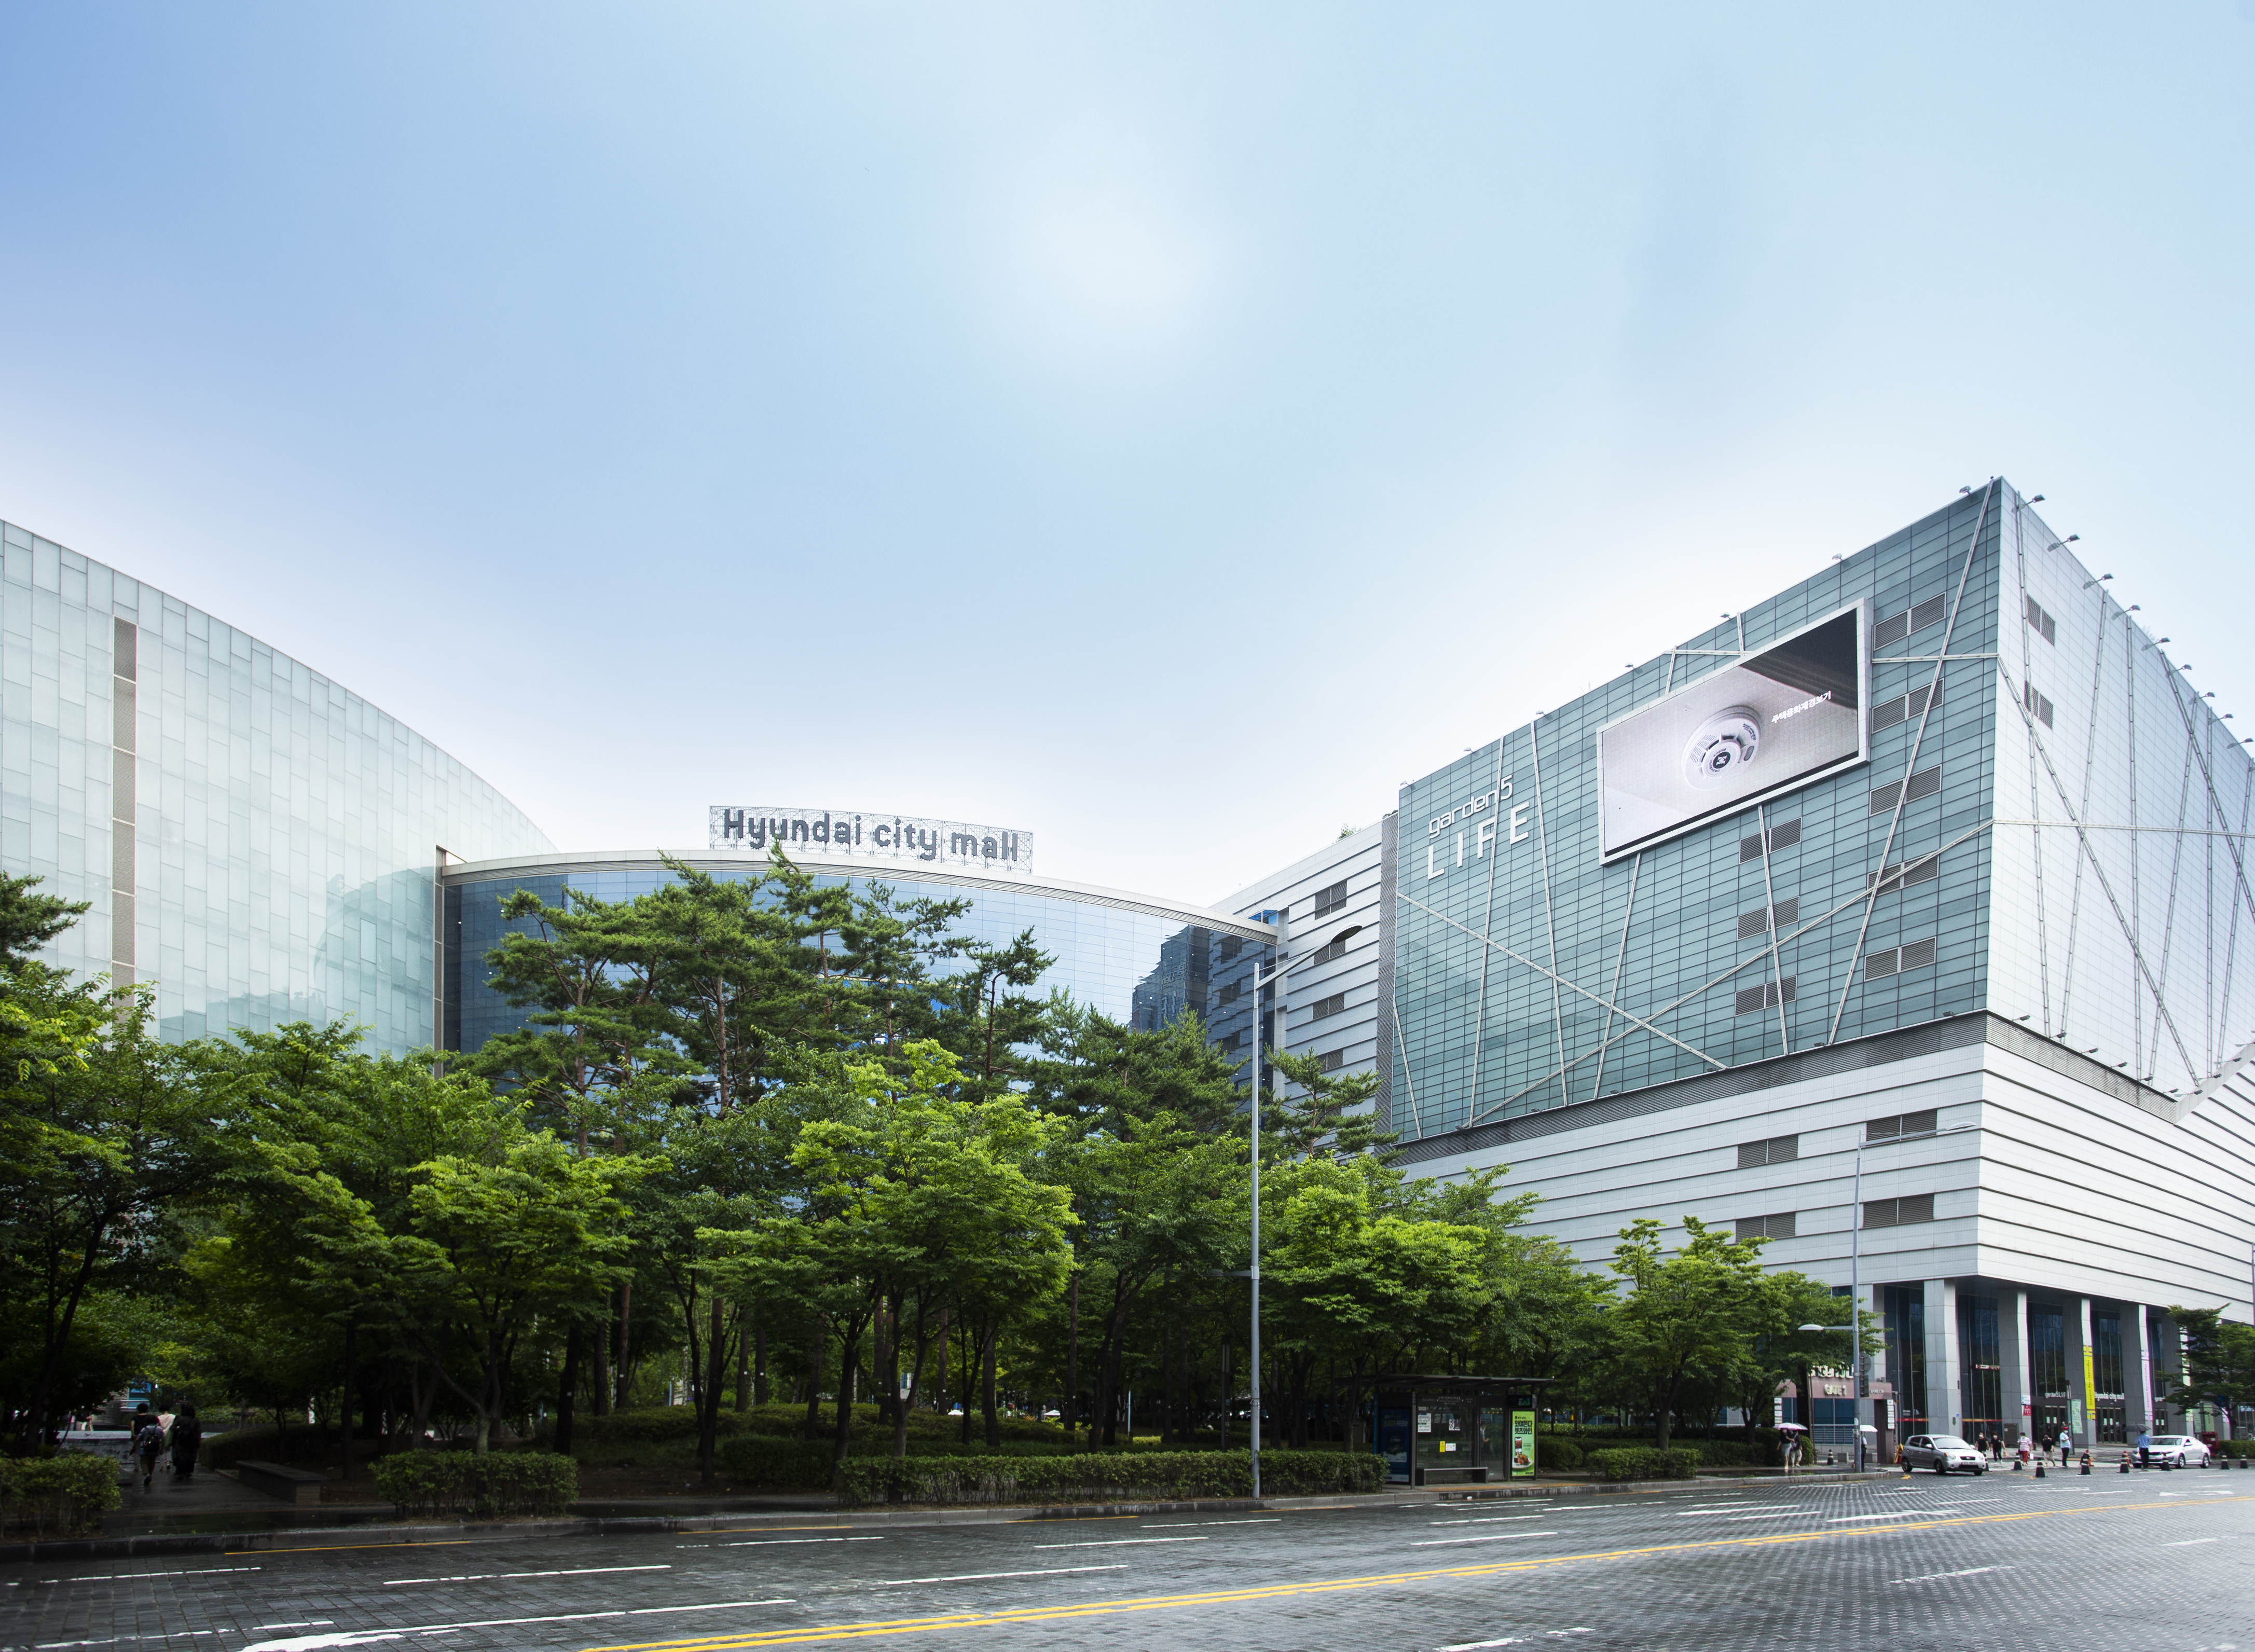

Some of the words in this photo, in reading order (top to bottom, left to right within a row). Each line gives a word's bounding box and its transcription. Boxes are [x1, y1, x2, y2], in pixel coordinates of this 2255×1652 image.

[1771, 690, 1832, 724] 주택용화재경보기
[1429, 775, 1513, 839] garden5
[724, 808, 862, 849] Hyundai
[874, 818, 937, 861] city
[951, 831, 1019, 861] mall
[1428, 801, 1530, 880] LIFE
[1824, 1384, 1841, 1395] GATE
[2094, 1391, 2109, 1401] Hyundai
